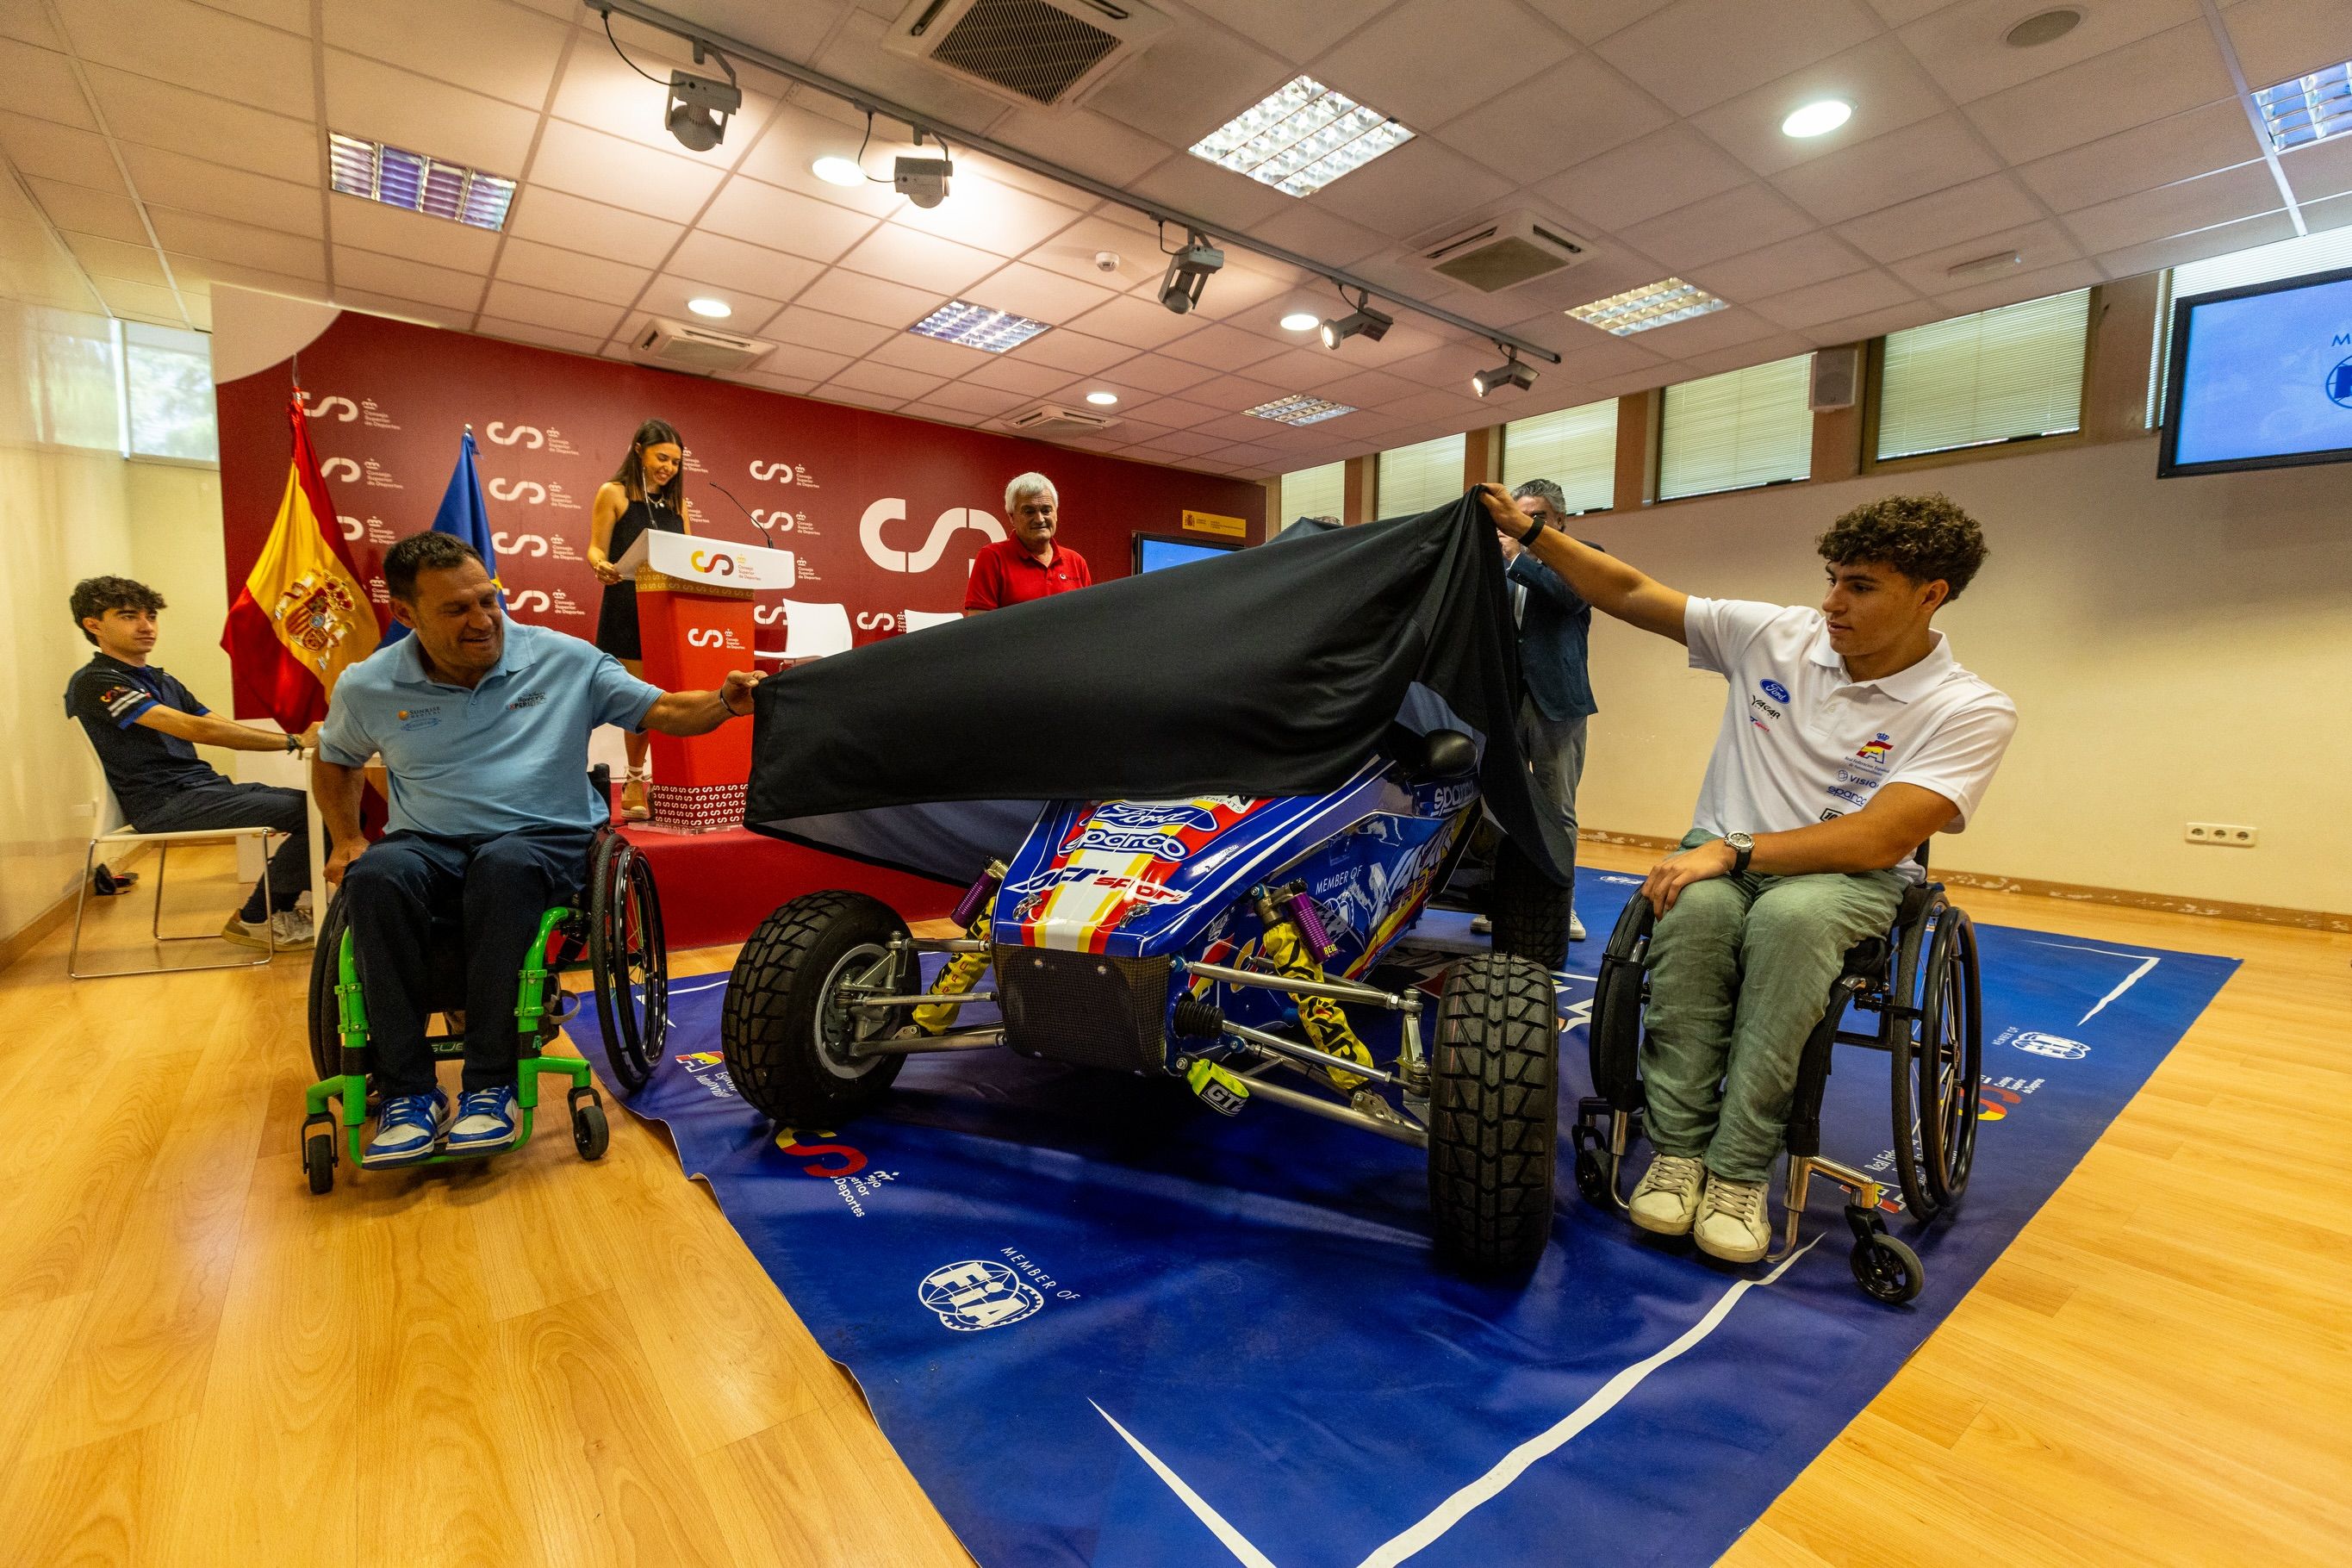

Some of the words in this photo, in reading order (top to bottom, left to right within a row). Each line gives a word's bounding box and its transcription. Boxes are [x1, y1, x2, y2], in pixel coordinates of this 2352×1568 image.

[1851, 775, 1879, 789] VISIO
[1095, 804, 1194, 824] Ford
[1316, 872, 1348, 896] MEMBER
[1350, 864, 1364, 880] OF
[834, 1178, 865, 1217] Deportes
[1000, 1247, 1057, 1291] MEMBER
[1056, 1290, 1081, 1301] OF
